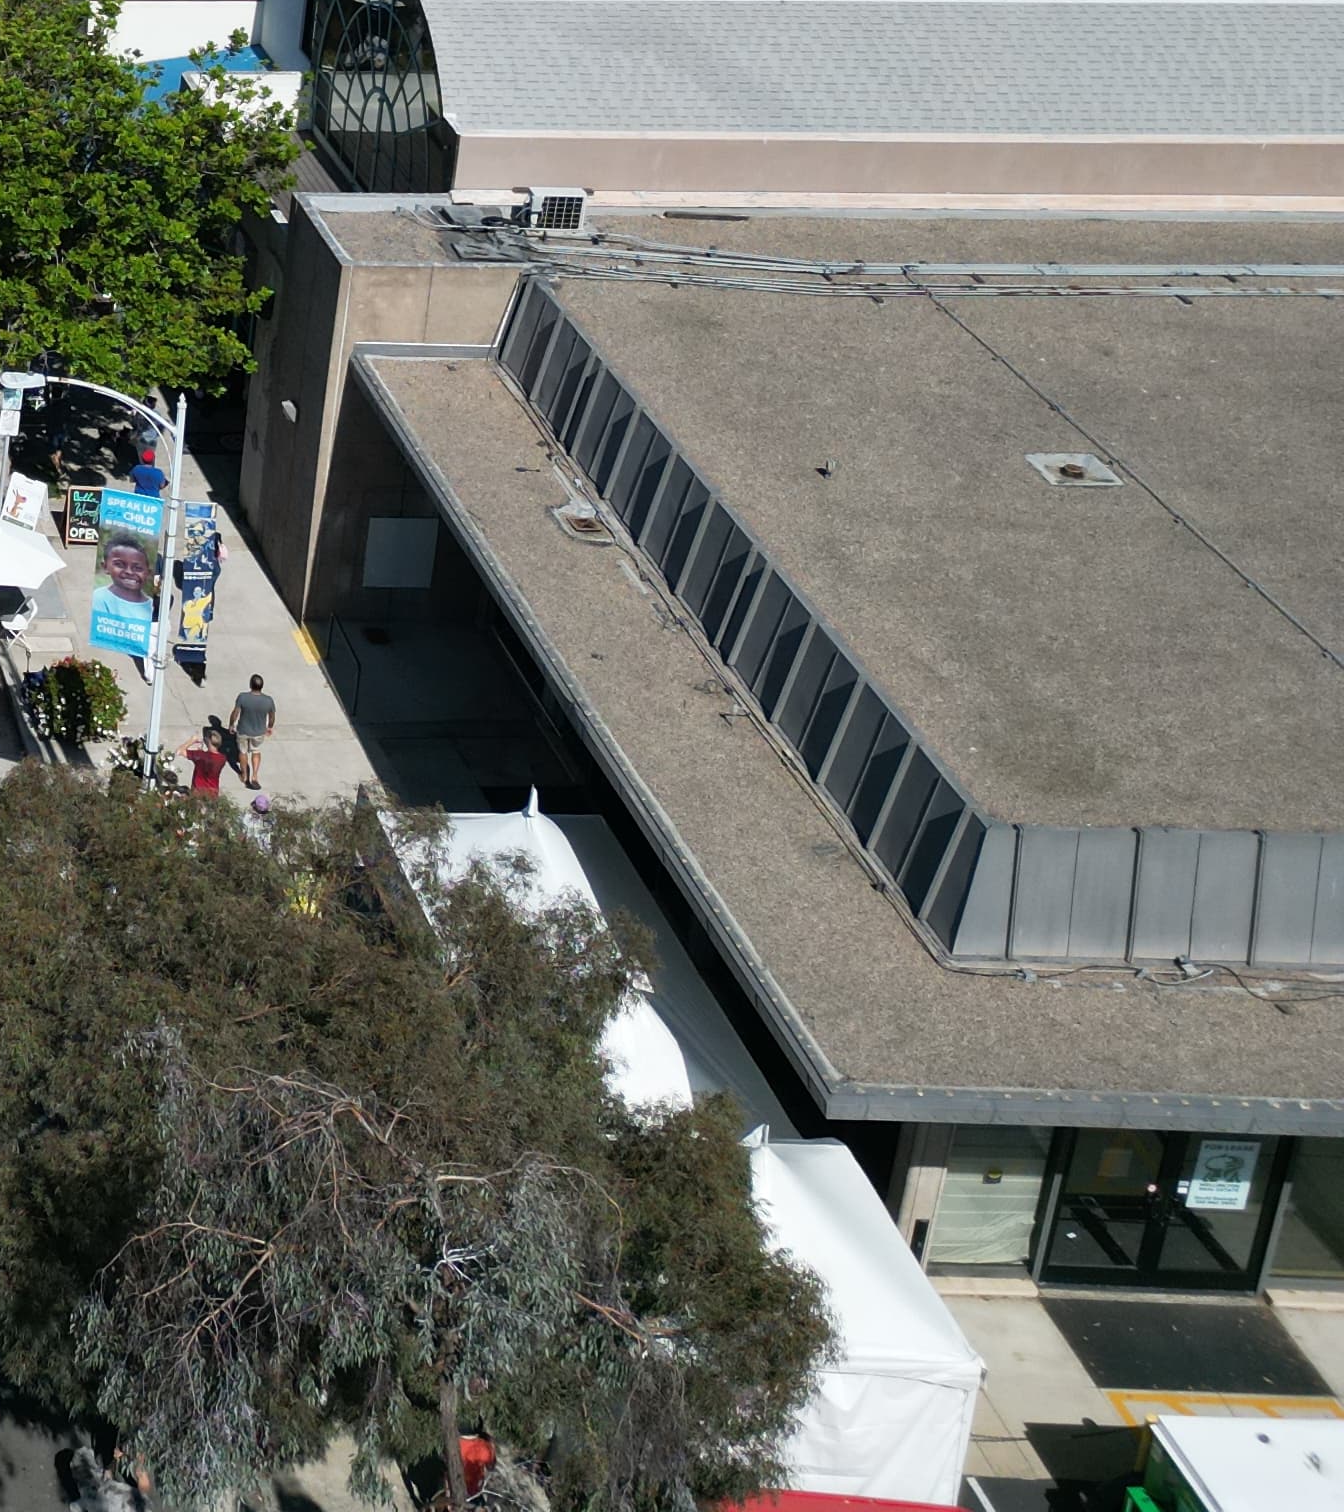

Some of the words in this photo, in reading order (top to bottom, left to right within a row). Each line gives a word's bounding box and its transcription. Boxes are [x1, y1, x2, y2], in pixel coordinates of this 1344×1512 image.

[107, 496, 140, 512] SPEAK
[143, 503, 158, 514] UP
[123, 511, 156, 527] CHILD
[69, 527, 100, 540] OPEN
[97, 615, 126, 629] VOICES
[127, 622, 145, 633] FOR
[96, 624, 145, 643] CHILDREN
